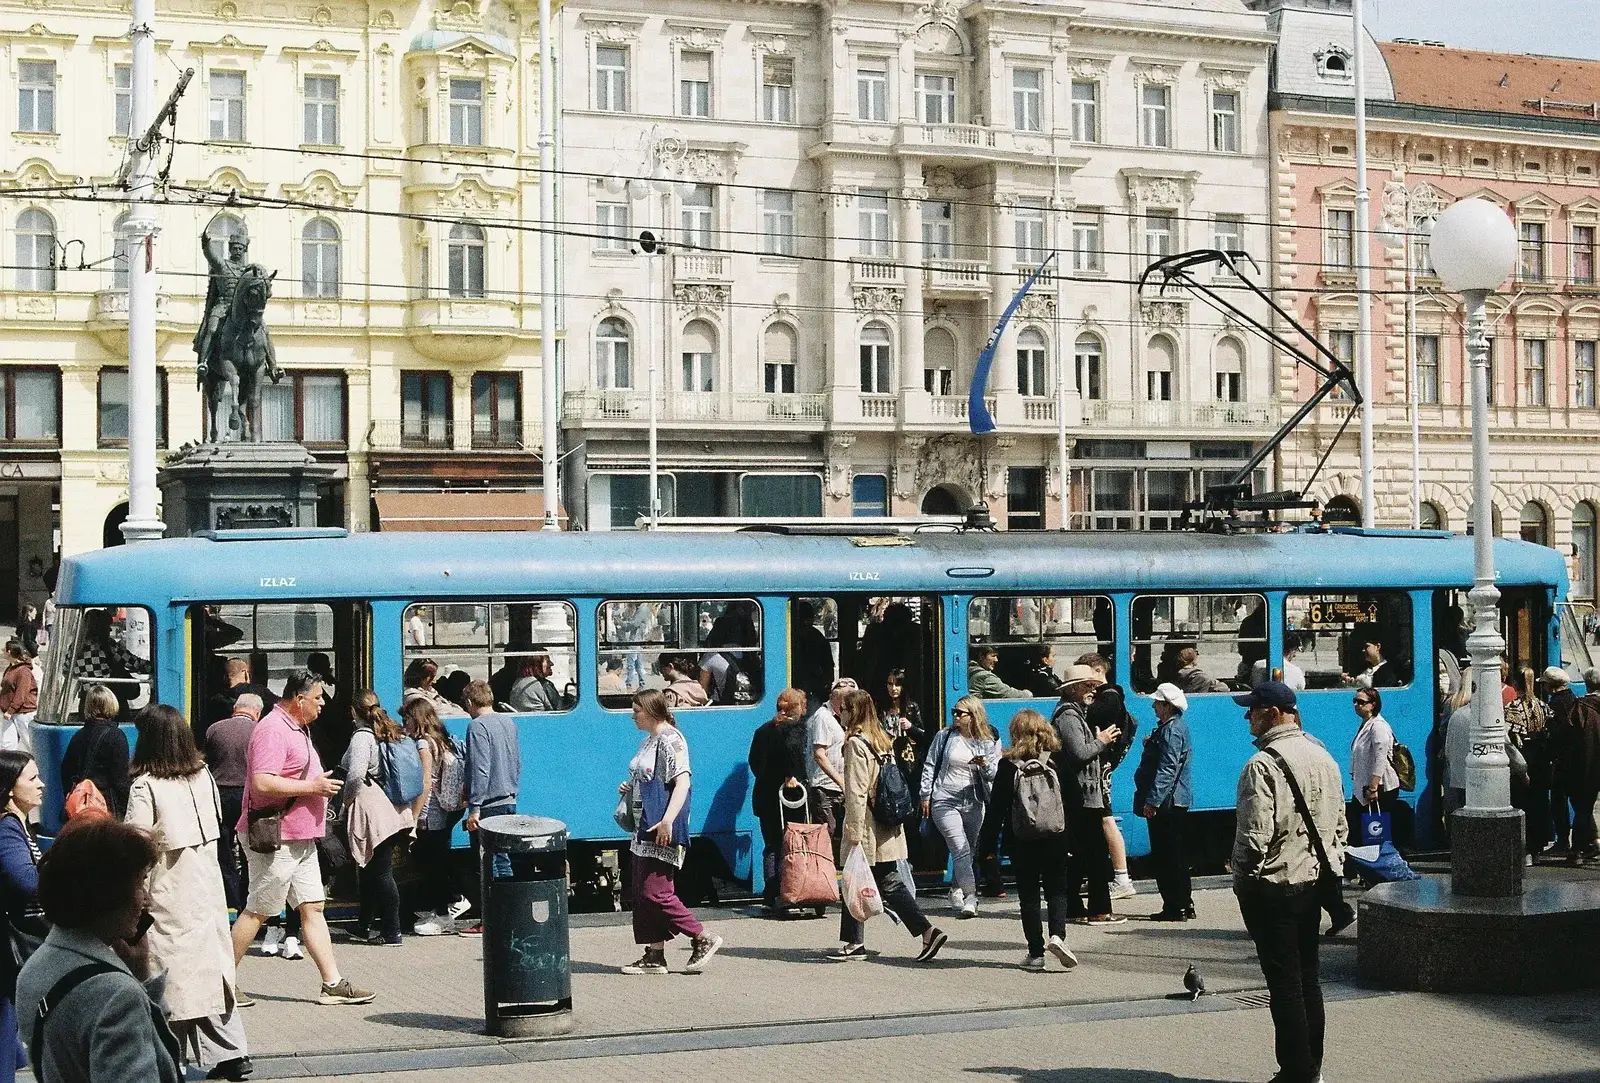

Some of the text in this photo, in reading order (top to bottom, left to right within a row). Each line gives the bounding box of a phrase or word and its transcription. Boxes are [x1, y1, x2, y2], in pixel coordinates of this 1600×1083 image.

[849, 571, 880, 581] IZLAZ
[260, 577, 296, 587] IZLAZ
[1311, 604, 1322, 622] 6
